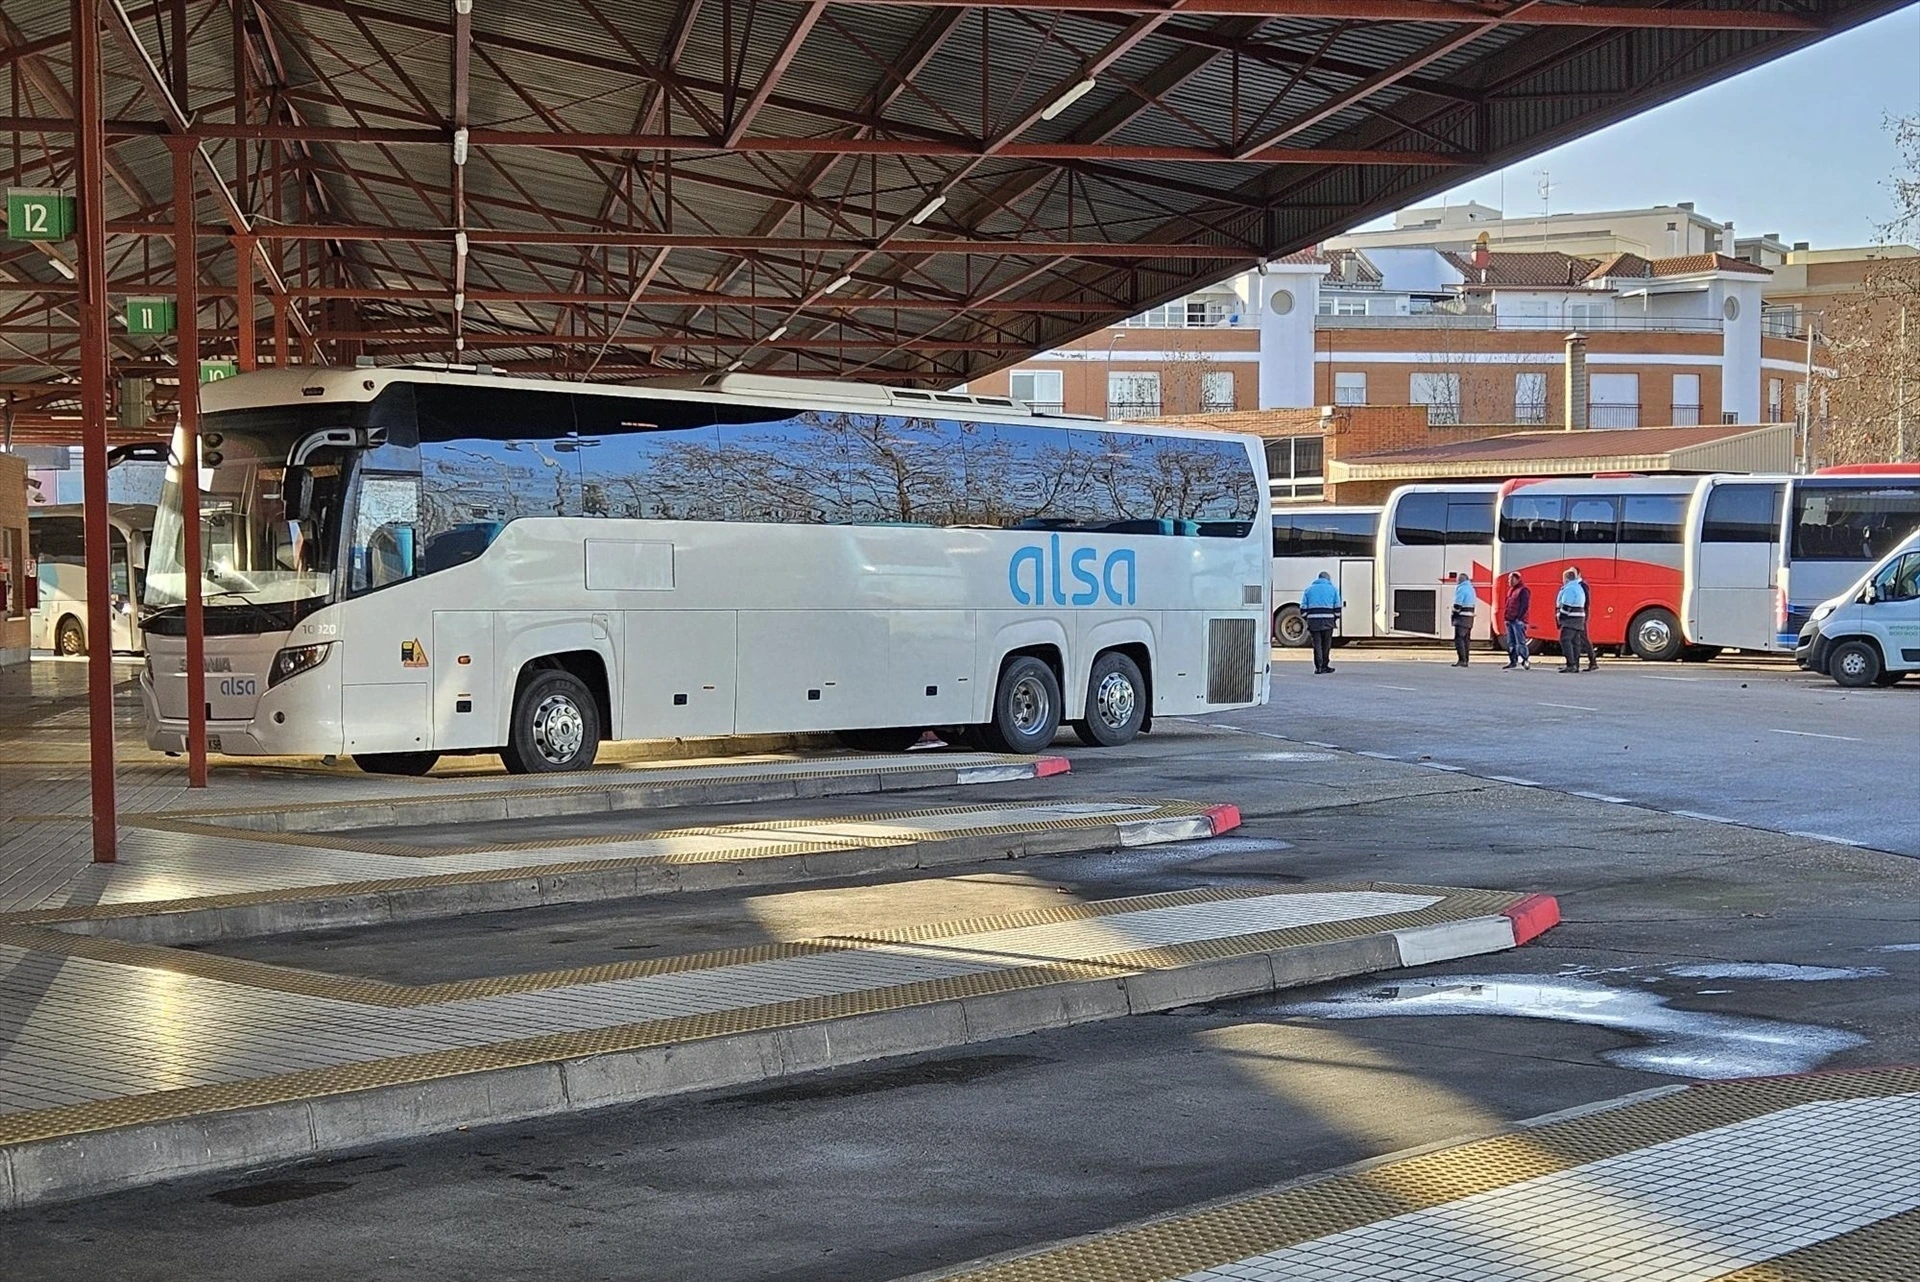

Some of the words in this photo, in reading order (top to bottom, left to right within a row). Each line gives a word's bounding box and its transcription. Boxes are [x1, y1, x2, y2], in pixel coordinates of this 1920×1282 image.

[24, 203, 48, 232] 12
[141, 308, 153, 329] 11
[208, 369, 225, 382] 10
[1008, 532, 1137, 606] alsa
[178, 656, 233, 673] SNIA
[220, 677, 256, 696] alsa
